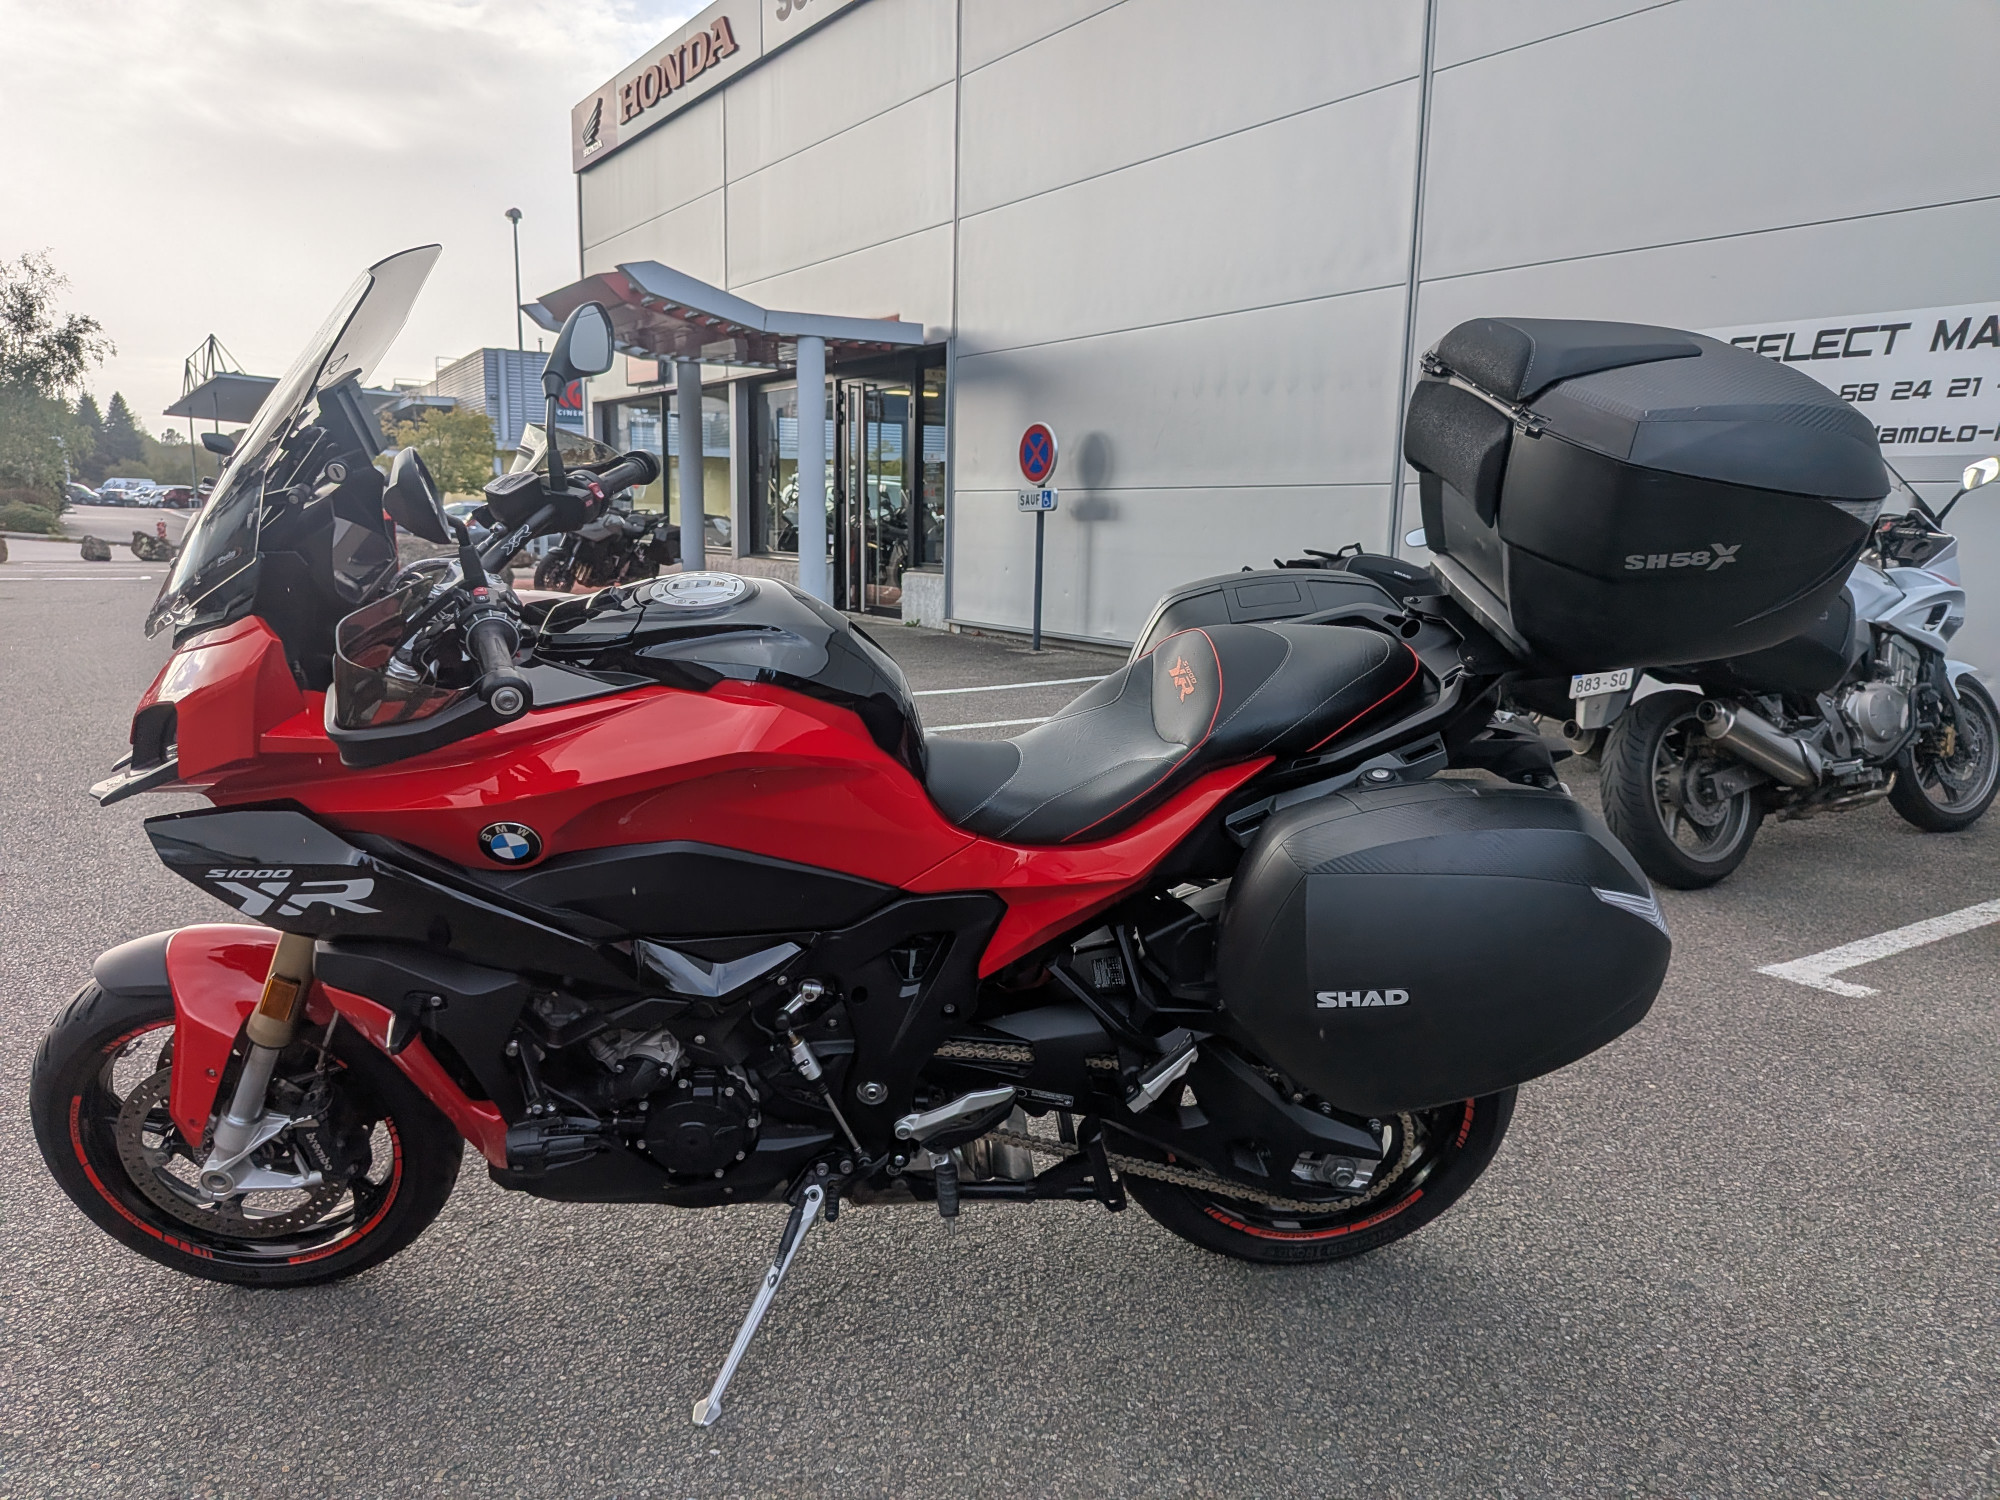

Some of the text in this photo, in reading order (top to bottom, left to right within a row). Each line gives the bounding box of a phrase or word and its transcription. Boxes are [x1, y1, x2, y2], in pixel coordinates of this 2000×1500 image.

[619, 16, 739, 125] HONDA
[1890, 380, 1932, 400] 24
[1946, 377, 1983, 397] 21
[1020, 494, 1040, 505] SAUF
[1624, 543, 1742, 571] SH58X
[1575, 672, 1628, 693] 883-SQ
[481, 824, 530, 842] BMW
[204, 869, 293, 879] S1000
[1316, 989, 1410, 1008] SHAD
[305, 1132, 333, 1171] brembo
